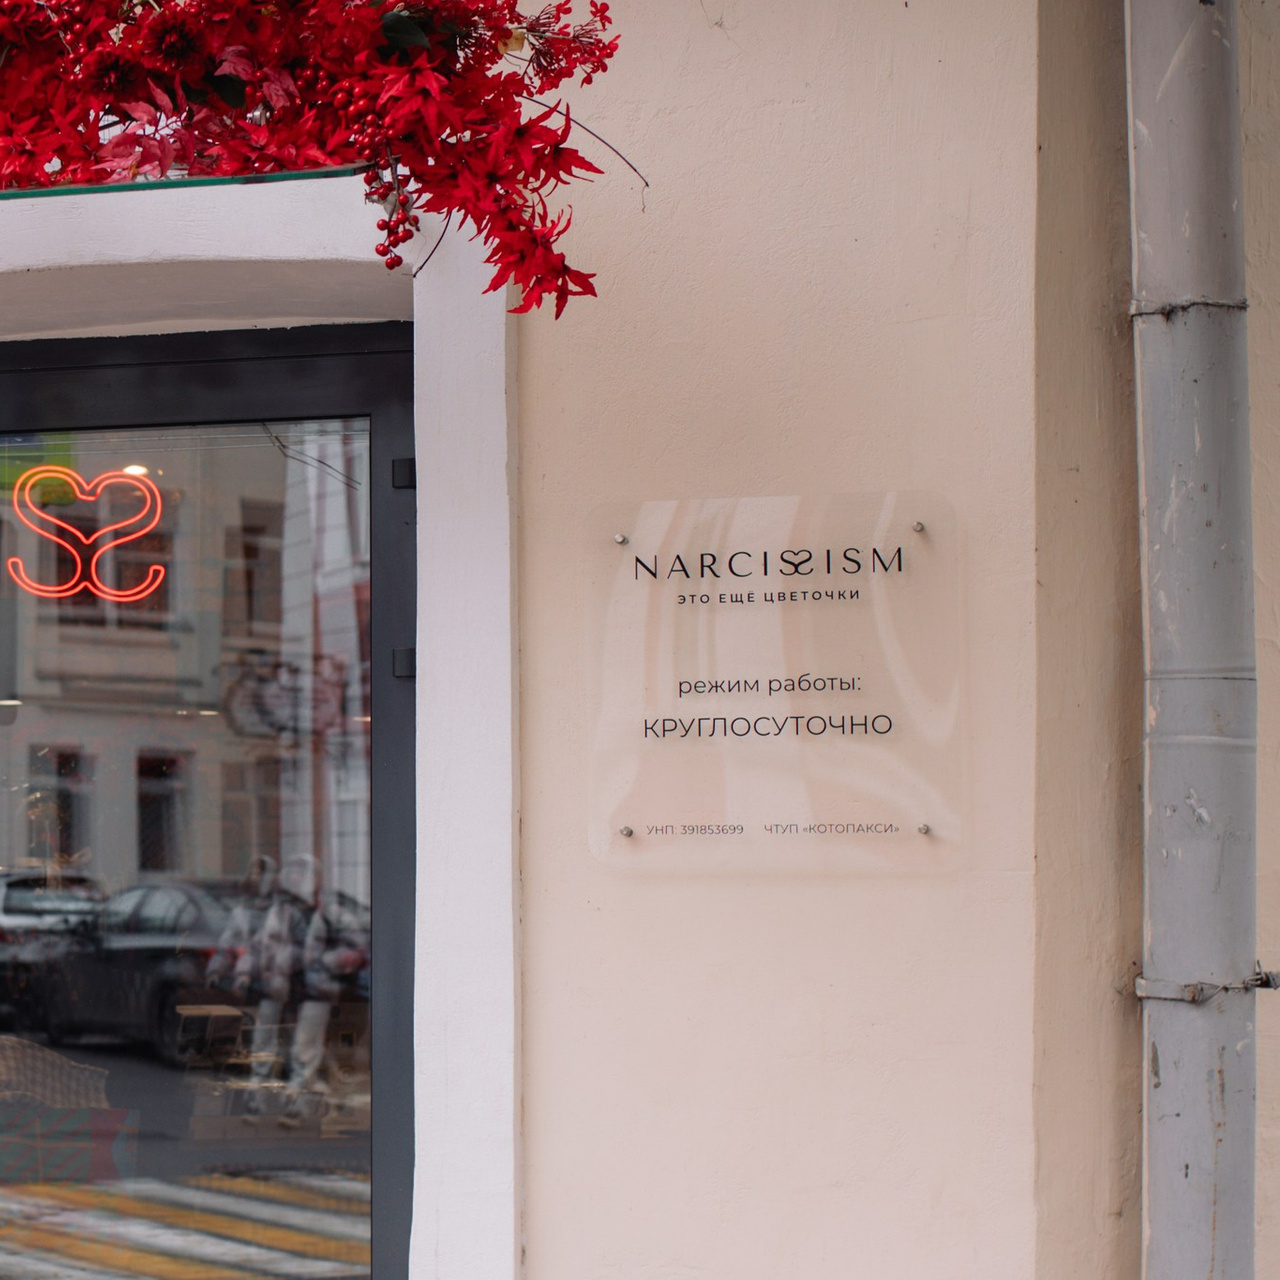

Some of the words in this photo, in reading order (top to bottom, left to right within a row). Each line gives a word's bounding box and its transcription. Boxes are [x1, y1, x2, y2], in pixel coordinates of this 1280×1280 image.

[635, 547, 903, 580] NARCISSISM
[678, 594, 710, 605] ЭТО
[719, 589, 755, 604] ЕЩЁ
[764, 590, 860, 604] ЦВЕТОЧКИ
[678, 680, 759, 698] режим
[769, 673, 861, 696] работы:
[644, 715, 893, 738] КРУГЛОСУТОЧНО
[646, 825, 677, 835] УНП:
[680, 825, 744, 835] 391853699
[764, 824, 799, 834] ЧТУП
[802, 823, 900, 834] «КОТОПАКСИ»
